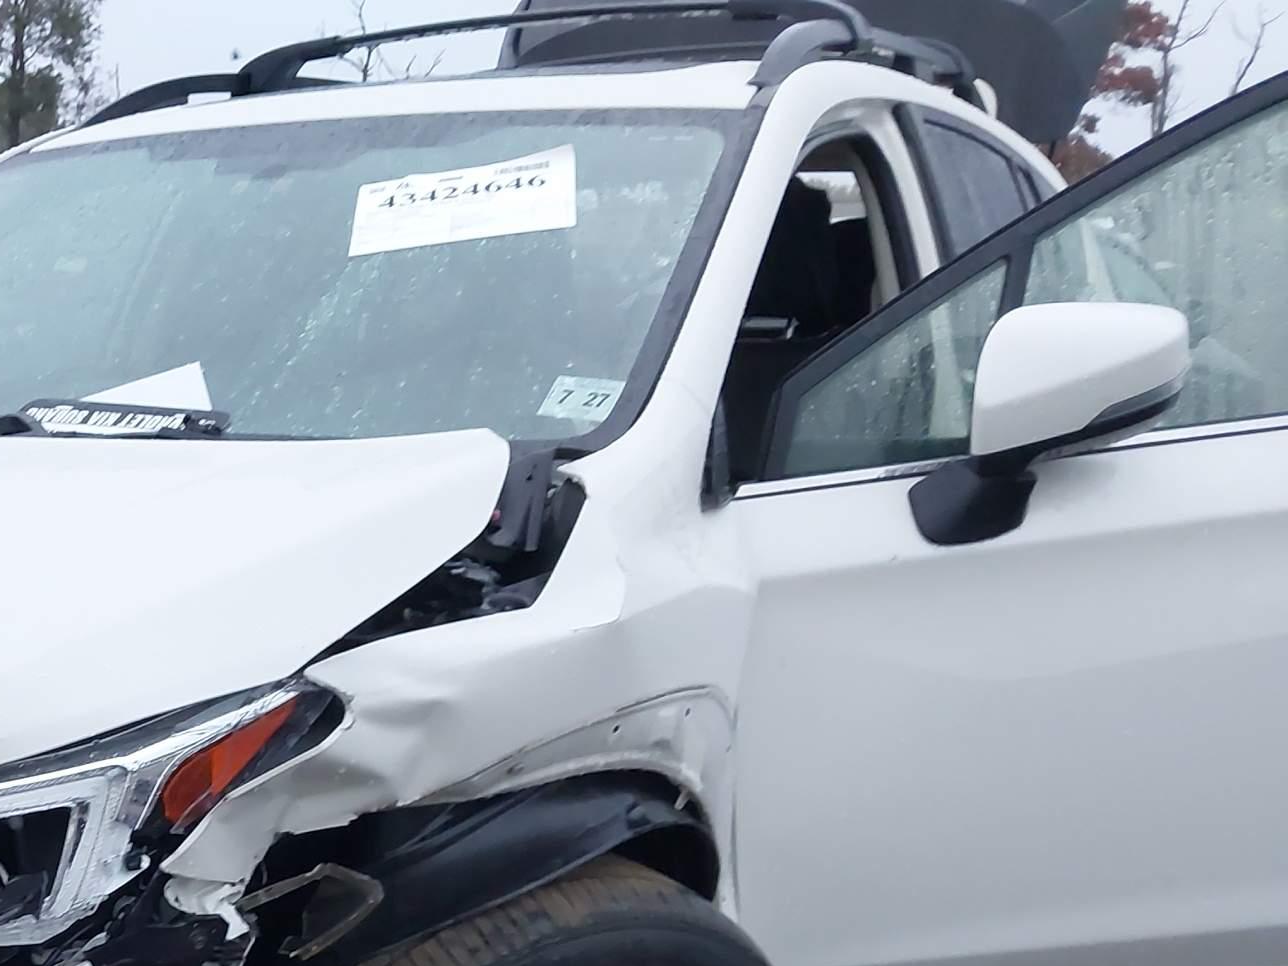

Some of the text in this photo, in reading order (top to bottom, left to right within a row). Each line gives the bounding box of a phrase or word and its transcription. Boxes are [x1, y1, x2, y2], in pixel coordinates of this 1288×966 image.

[377, 175, 547, 208] 43424646
[557, 389, 611, 408] 7 27
